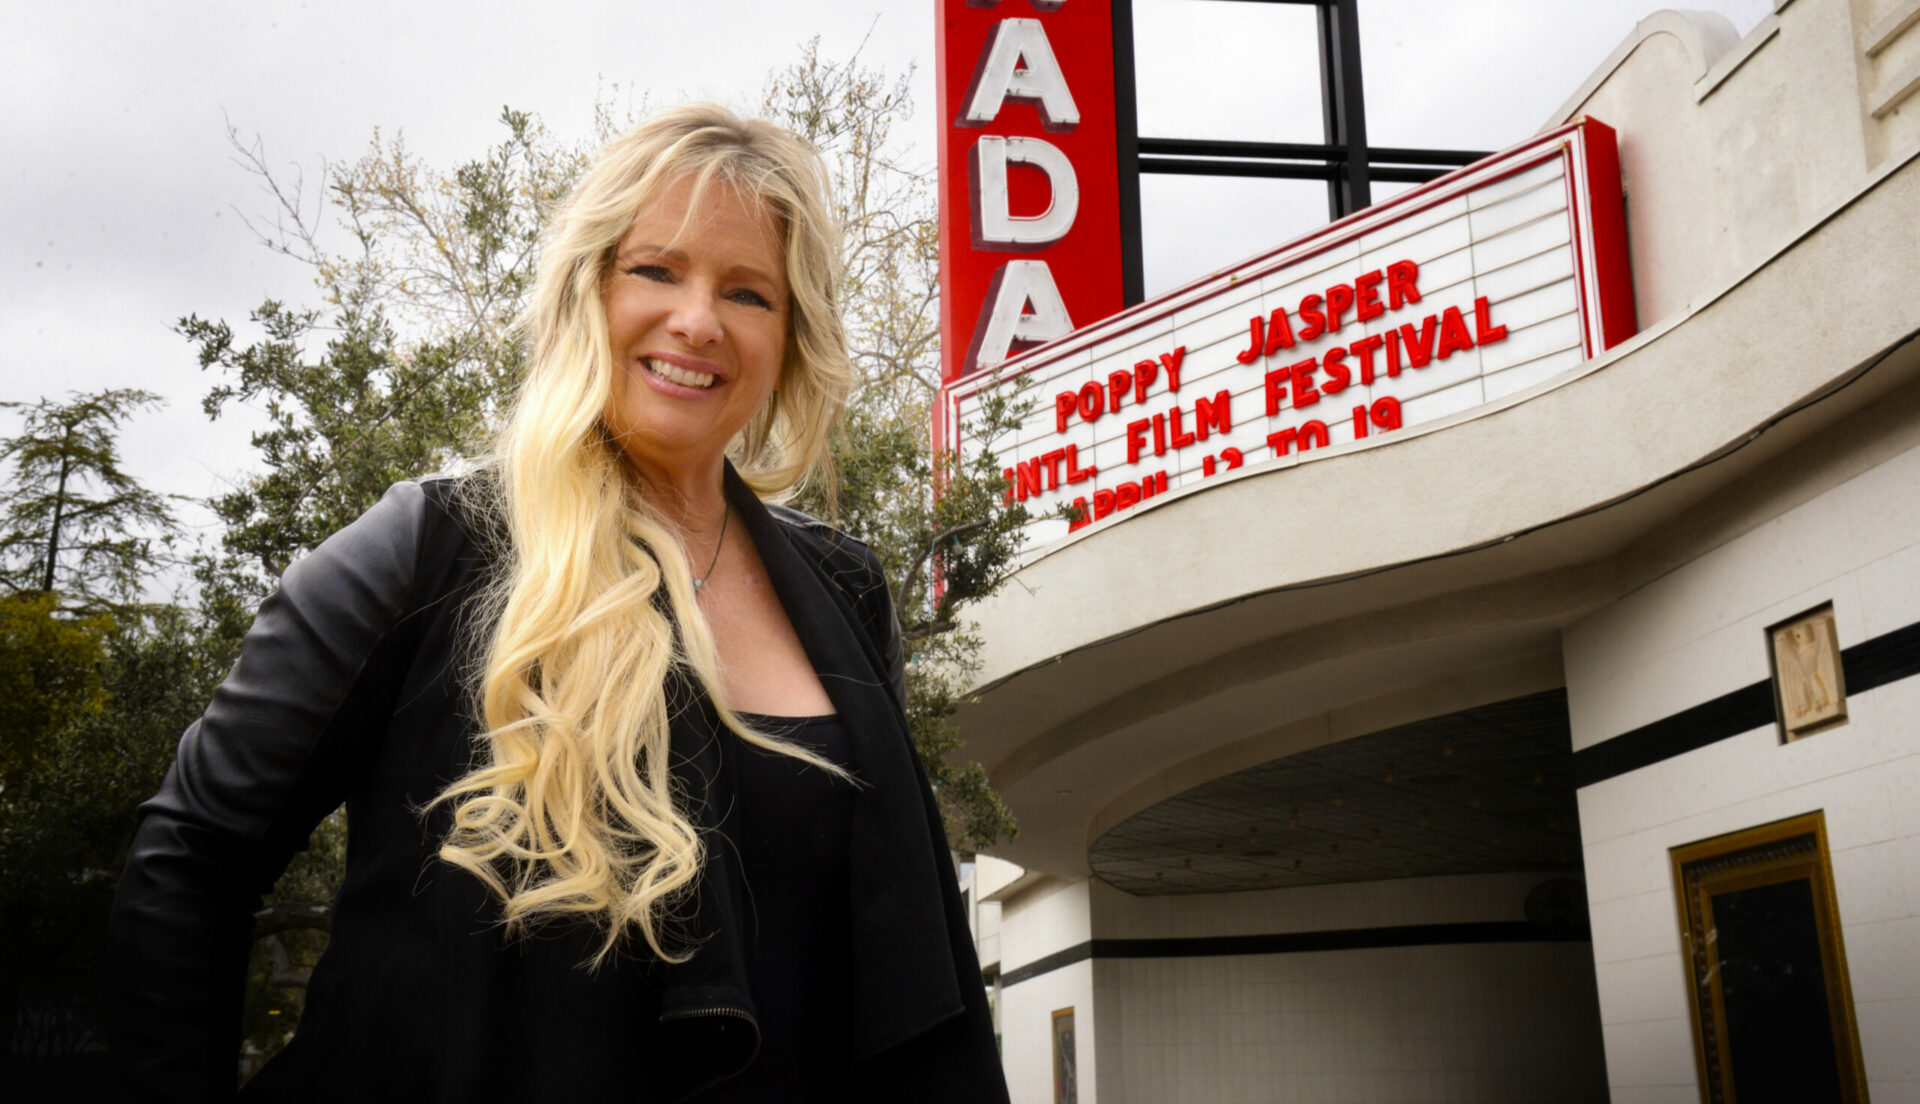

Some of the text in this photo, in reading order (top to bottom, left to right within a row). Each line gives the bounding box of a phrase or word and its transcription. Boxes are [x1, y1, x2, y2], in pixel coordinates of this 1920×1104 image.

[962, 0, 1081, 371] ADA
[1003, 295, 1508, 507] INTL. FILM FESTIVAL
[1055, 259, 1423, 434] POPPY JASPER
[1352, 395, 1403, 441] 19
